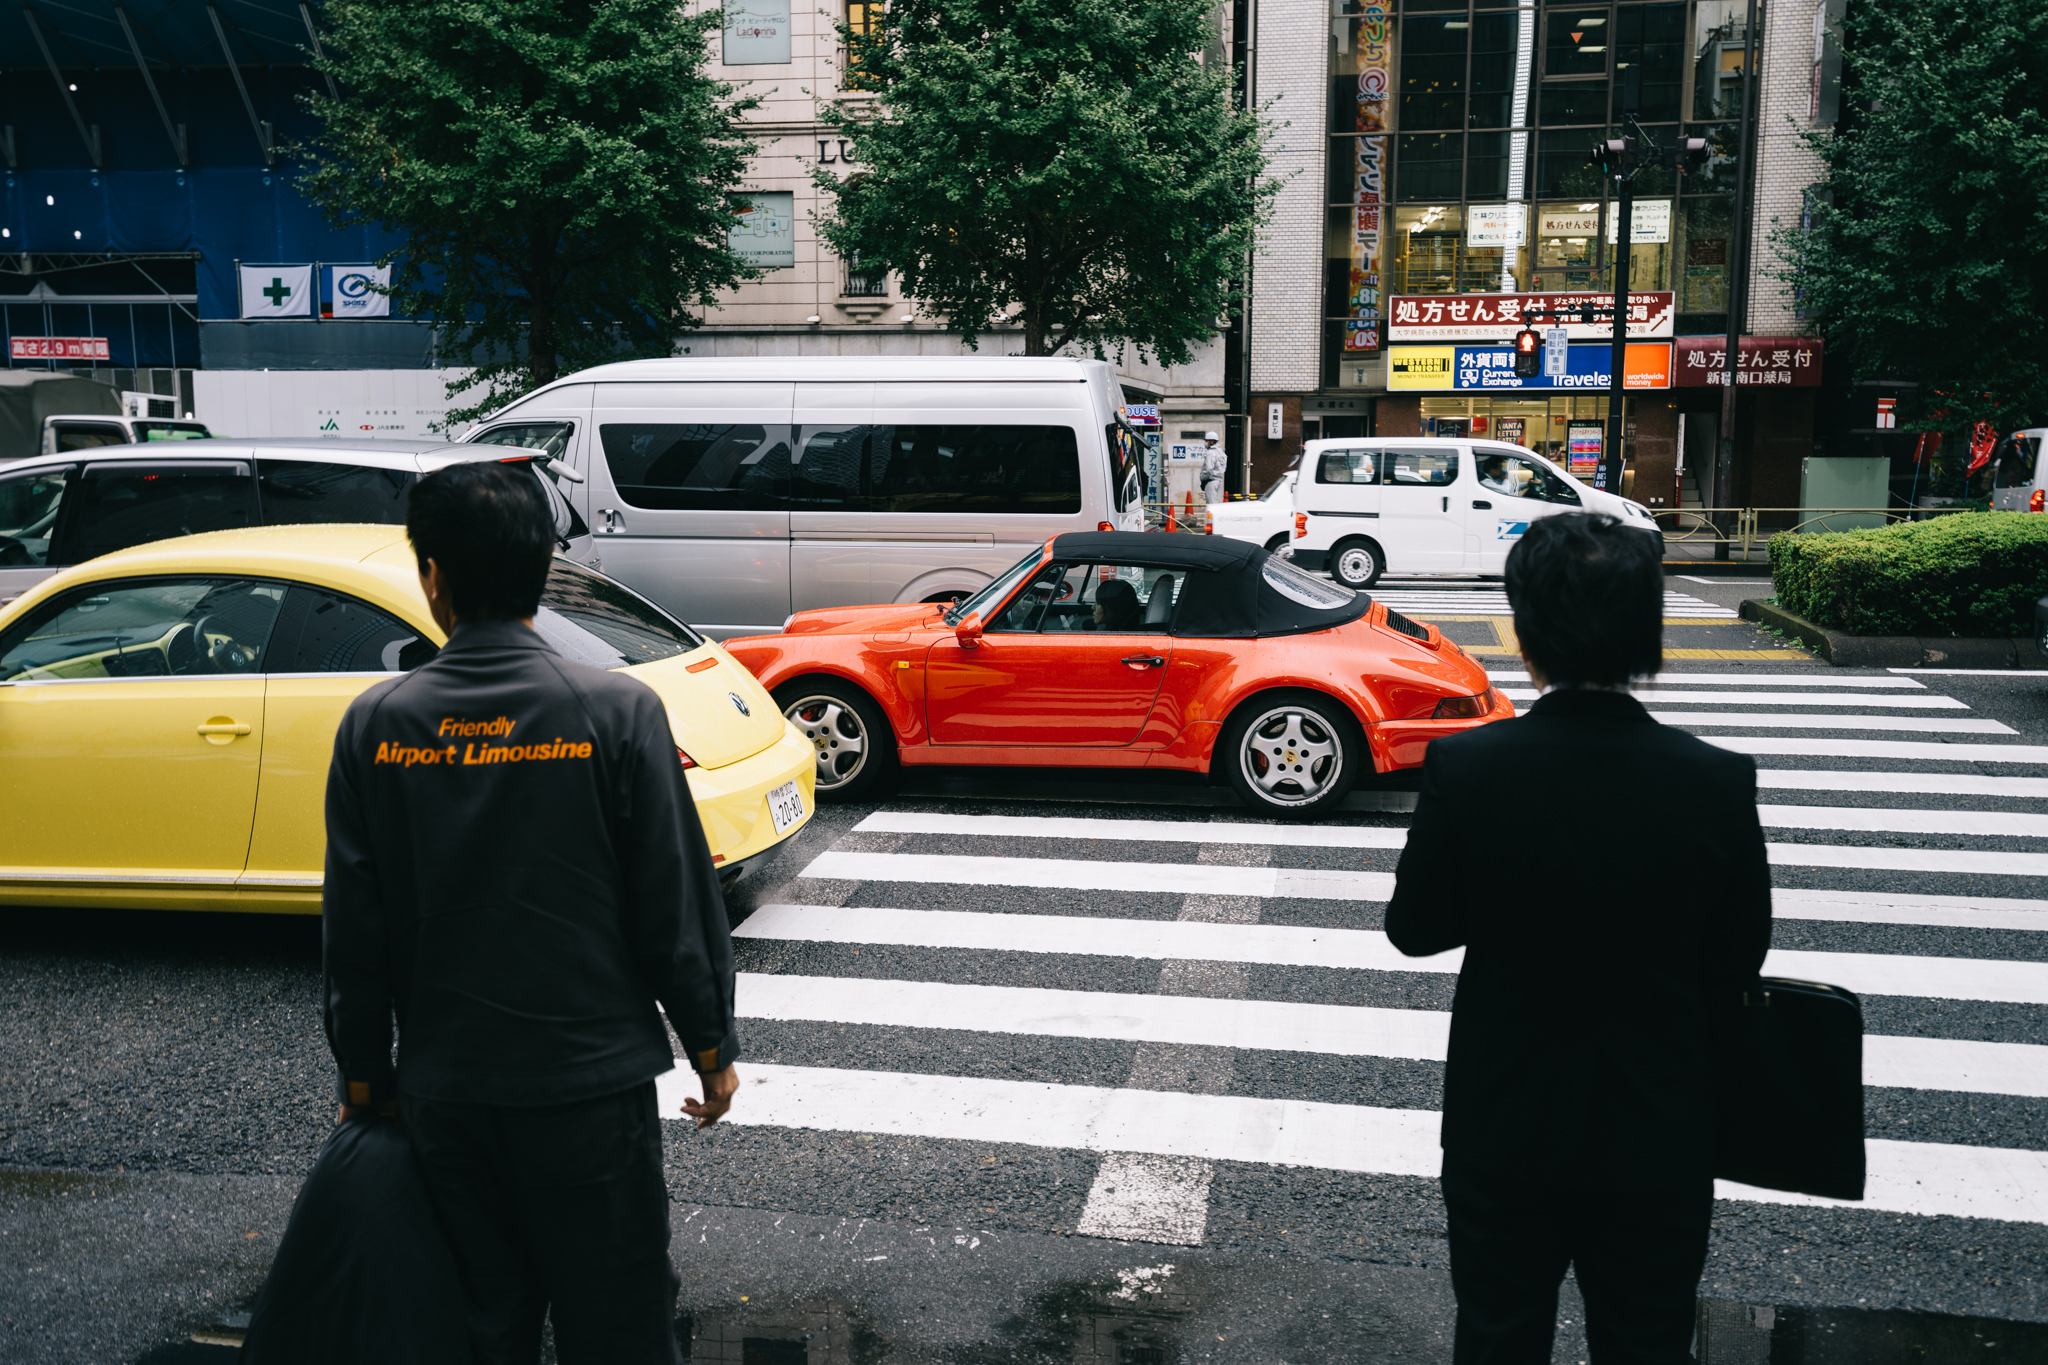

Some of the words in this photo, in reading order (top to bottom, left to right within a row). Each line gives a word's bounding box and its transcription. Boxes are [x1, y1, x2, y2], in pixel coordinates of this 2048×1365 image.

[1396, 298, 1547, 323] 処方せん受付
[1393, 358, 1440, 366] WESTERN
[1687, 349, 1813, 368] 処方せん受付
[1482, 377, 1523, 387] Exchange
[1627, 379, 1651, 387] money
[438, 716, 516, 738] Friendly
[374, 741, 457, 768] Airport
[462, 737, 593, 765] Limousine
